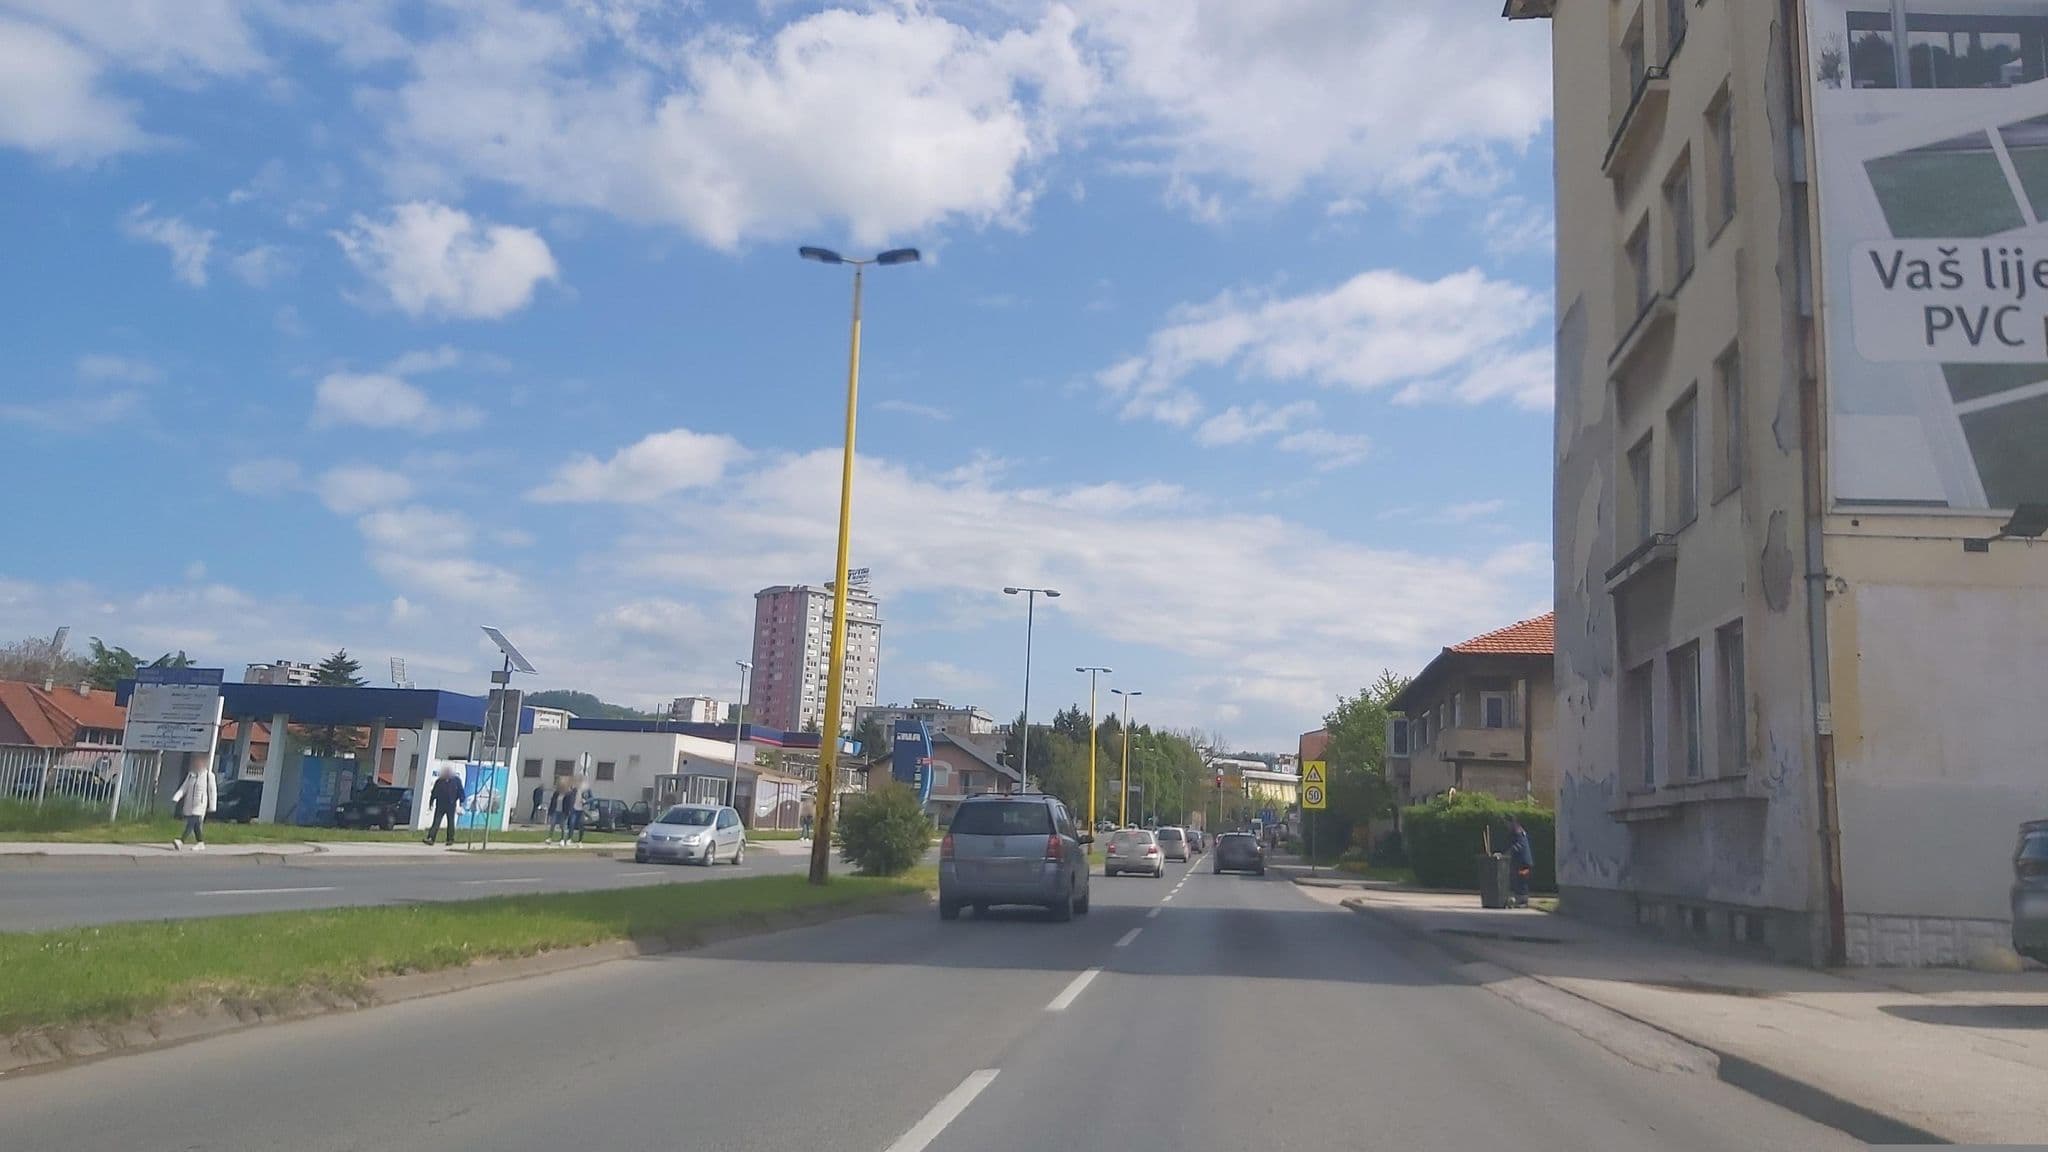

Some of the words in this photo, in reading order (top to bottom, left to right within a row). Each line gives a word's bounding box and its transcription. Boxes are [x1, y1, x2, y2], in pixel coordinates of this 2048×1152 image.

[1868, 246, 1964, 290] Vaš
[1924, 305, 2026, 346] PVC
[1308, 790, 1319, 801] 50
